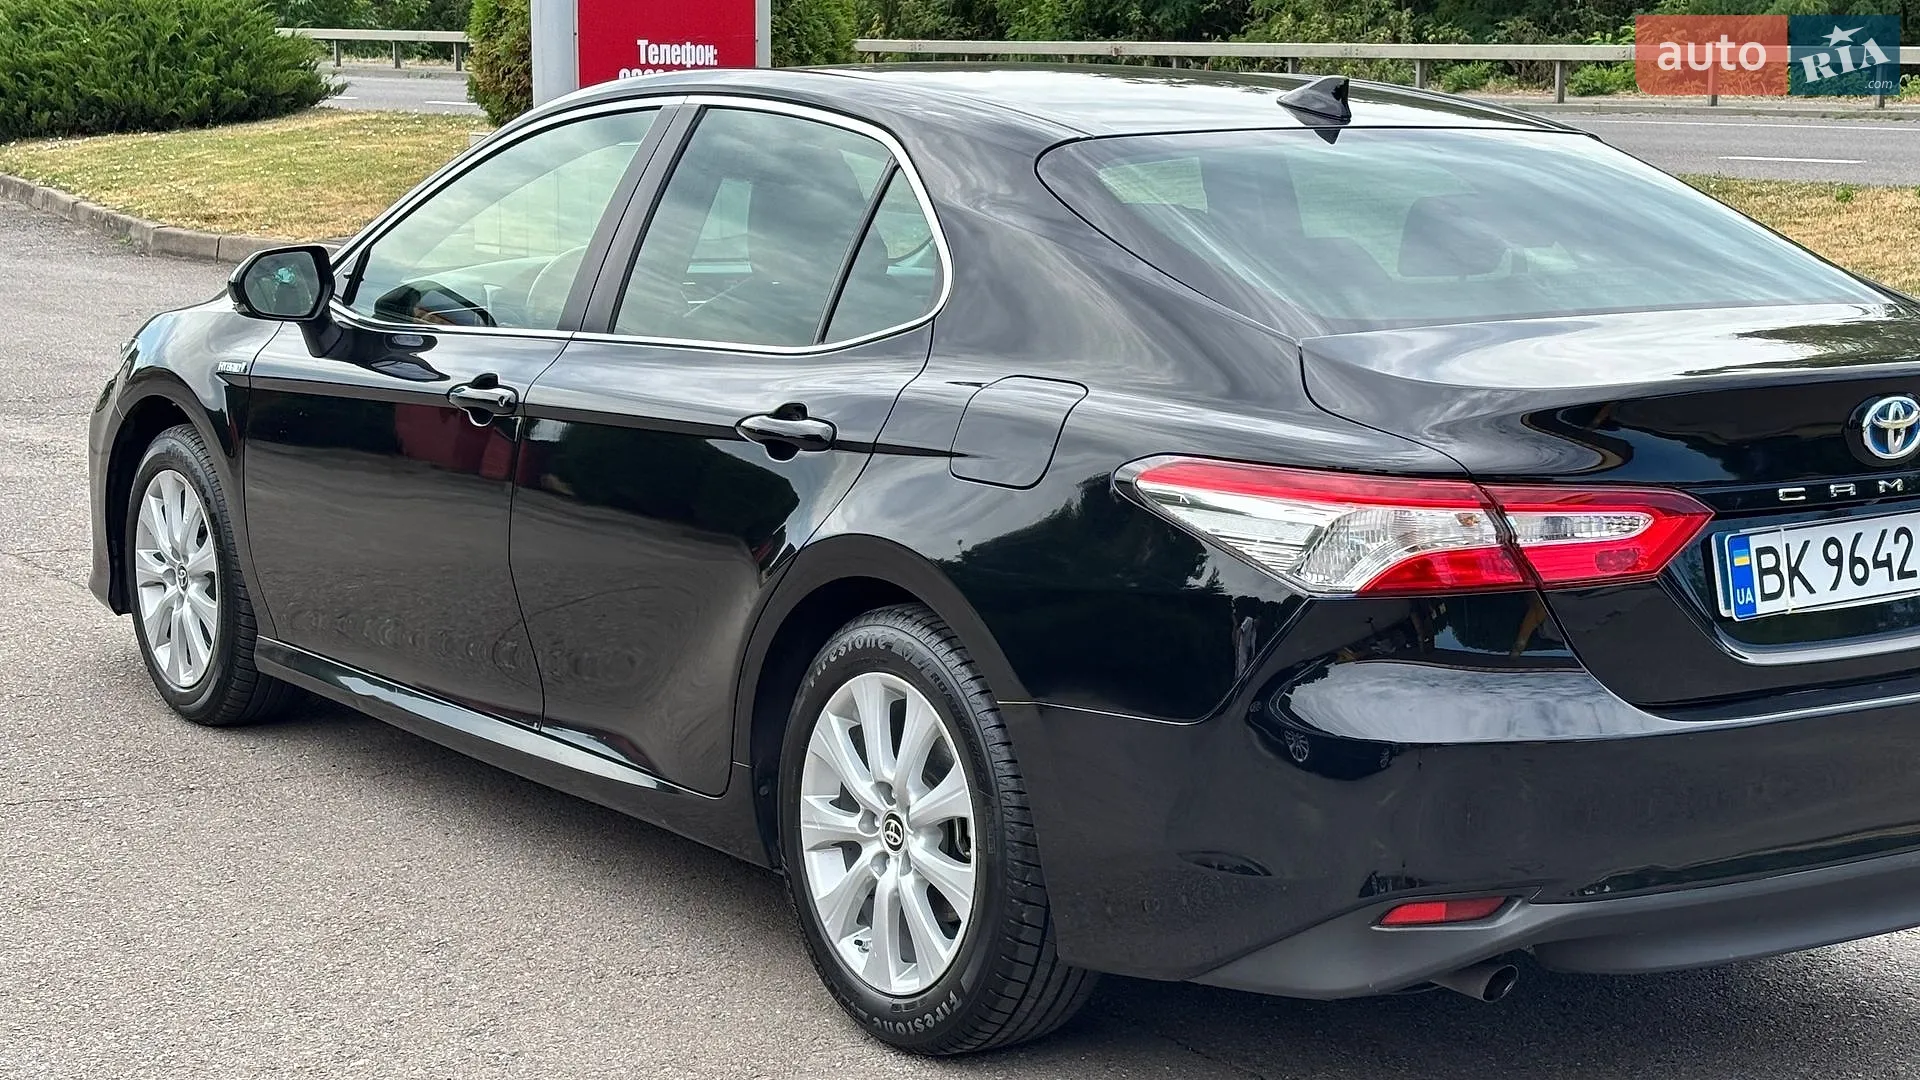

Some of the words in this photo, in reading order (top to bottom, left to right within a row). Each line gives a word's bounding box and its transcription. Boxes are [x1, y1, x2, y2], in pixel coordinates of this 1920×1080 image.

[637, 39, 718, 68] Телефон:
[1754, 539, 1817, 602] BK
[1822, 525, 1918, 592] 9642
[1736, 588, 1754, 605] UA
[872, 989, 963, 1036] Firestone
